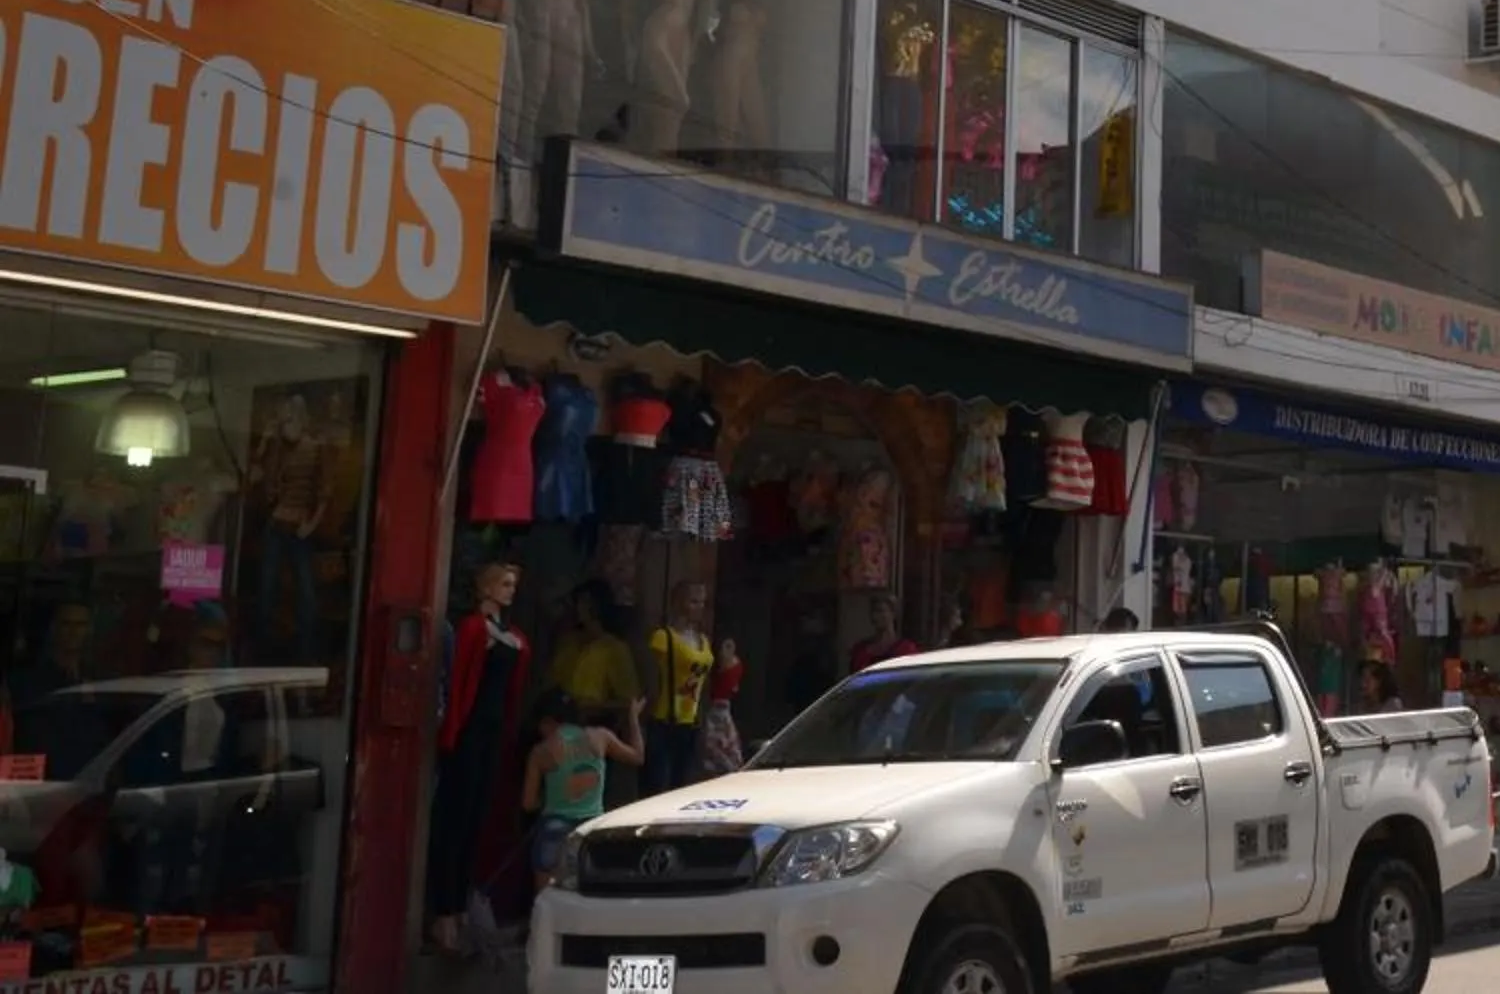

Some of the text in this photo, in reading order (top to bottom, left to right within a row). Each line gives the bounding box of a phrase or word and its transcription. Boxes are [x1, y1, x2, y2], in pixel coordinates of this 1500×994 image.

[0, 11, 470, 300] RECIOS
[738, 205, 1079, 325] Centro Estrella
[1353, 293, 1427, 333] MO
[1275, 406, 1387, 447] DISTRIBUIDORA
[1390, 427, 1408, 450] DE
[142, 969, 180, 994] AL
[195, 960, 291, 993] DETAL
